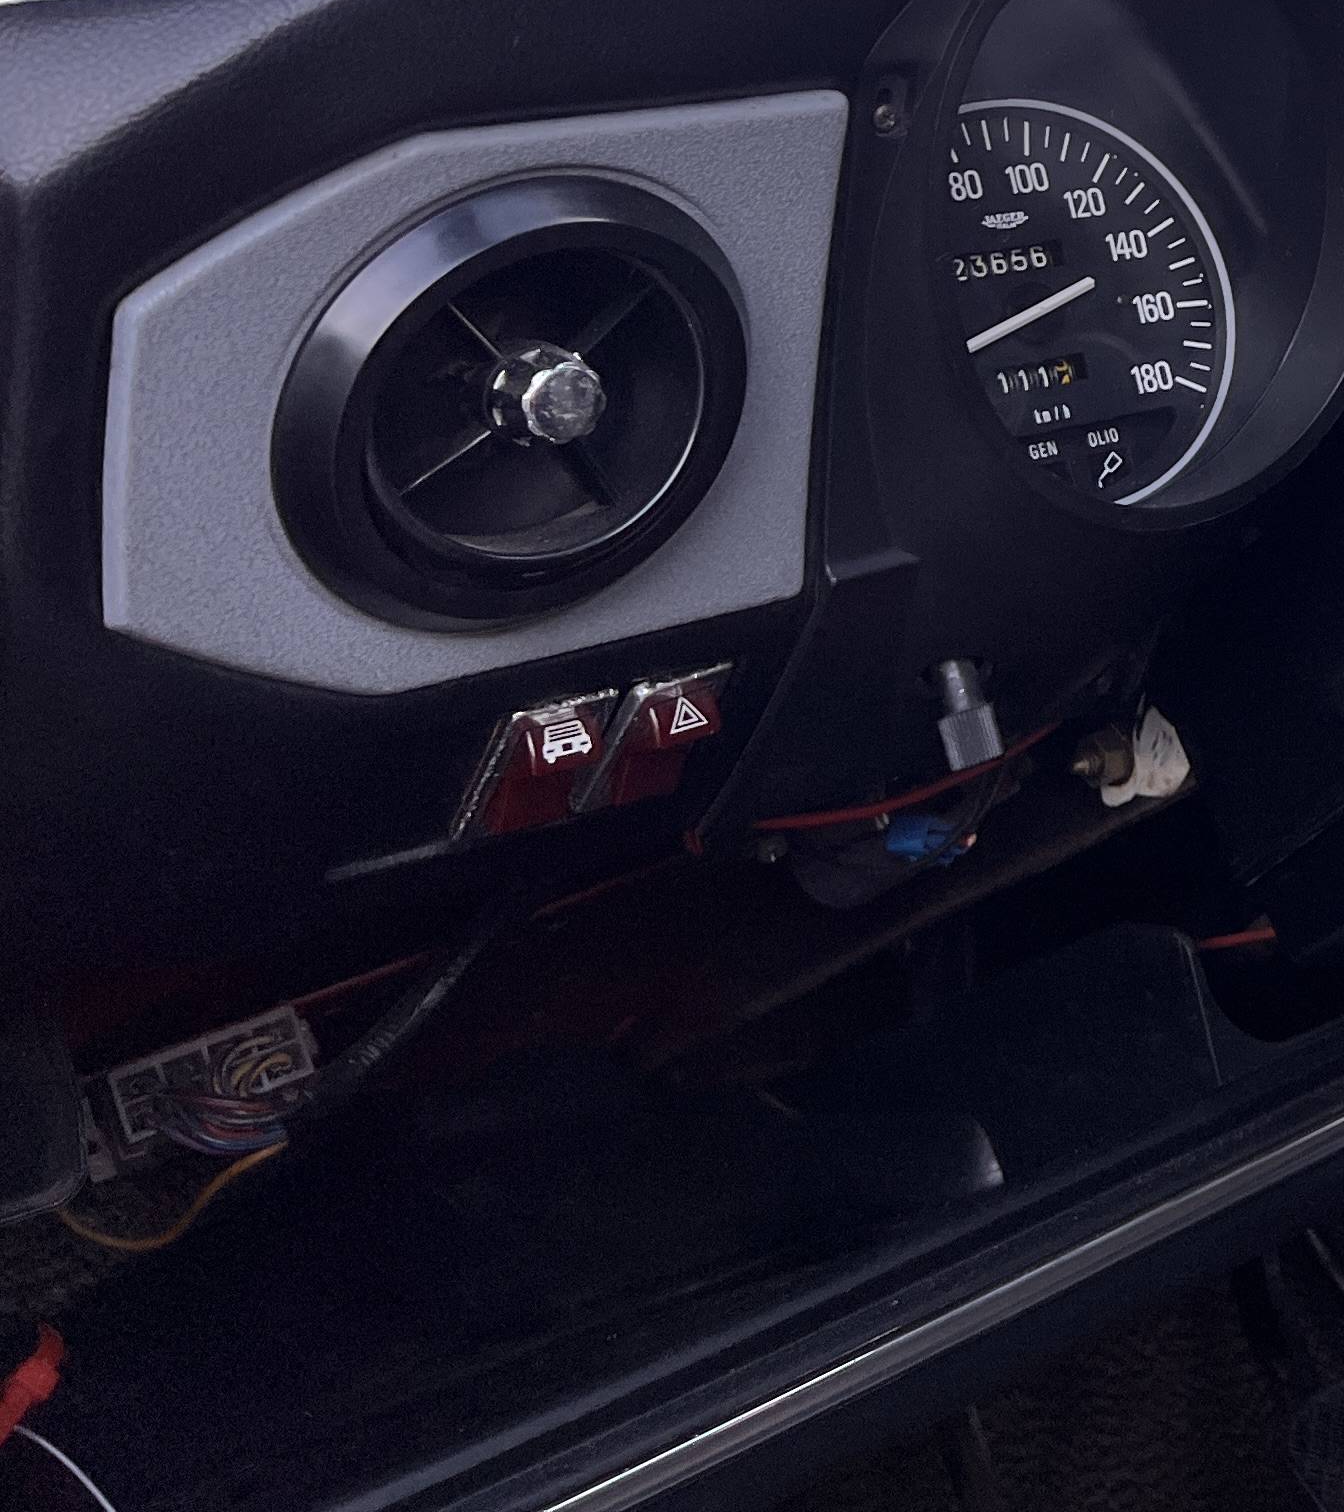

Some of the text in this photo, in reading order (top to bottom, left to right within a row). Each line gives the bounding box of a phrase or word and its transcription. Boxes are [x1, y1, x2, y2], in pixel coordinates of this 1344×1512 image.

[949, 170, 983, 201] 80
[1005, 162, 1049, 194] 100
[1063, 188, 1106, 219] 120
[1105, 229, 1148, 262] 140
[1132, 291, 1175, 324] 160
[1130, 360, 1174, 395] 180
[1028, 440, 1058, 460] GEN
[1087, 427, 1119, 448] OLIO
